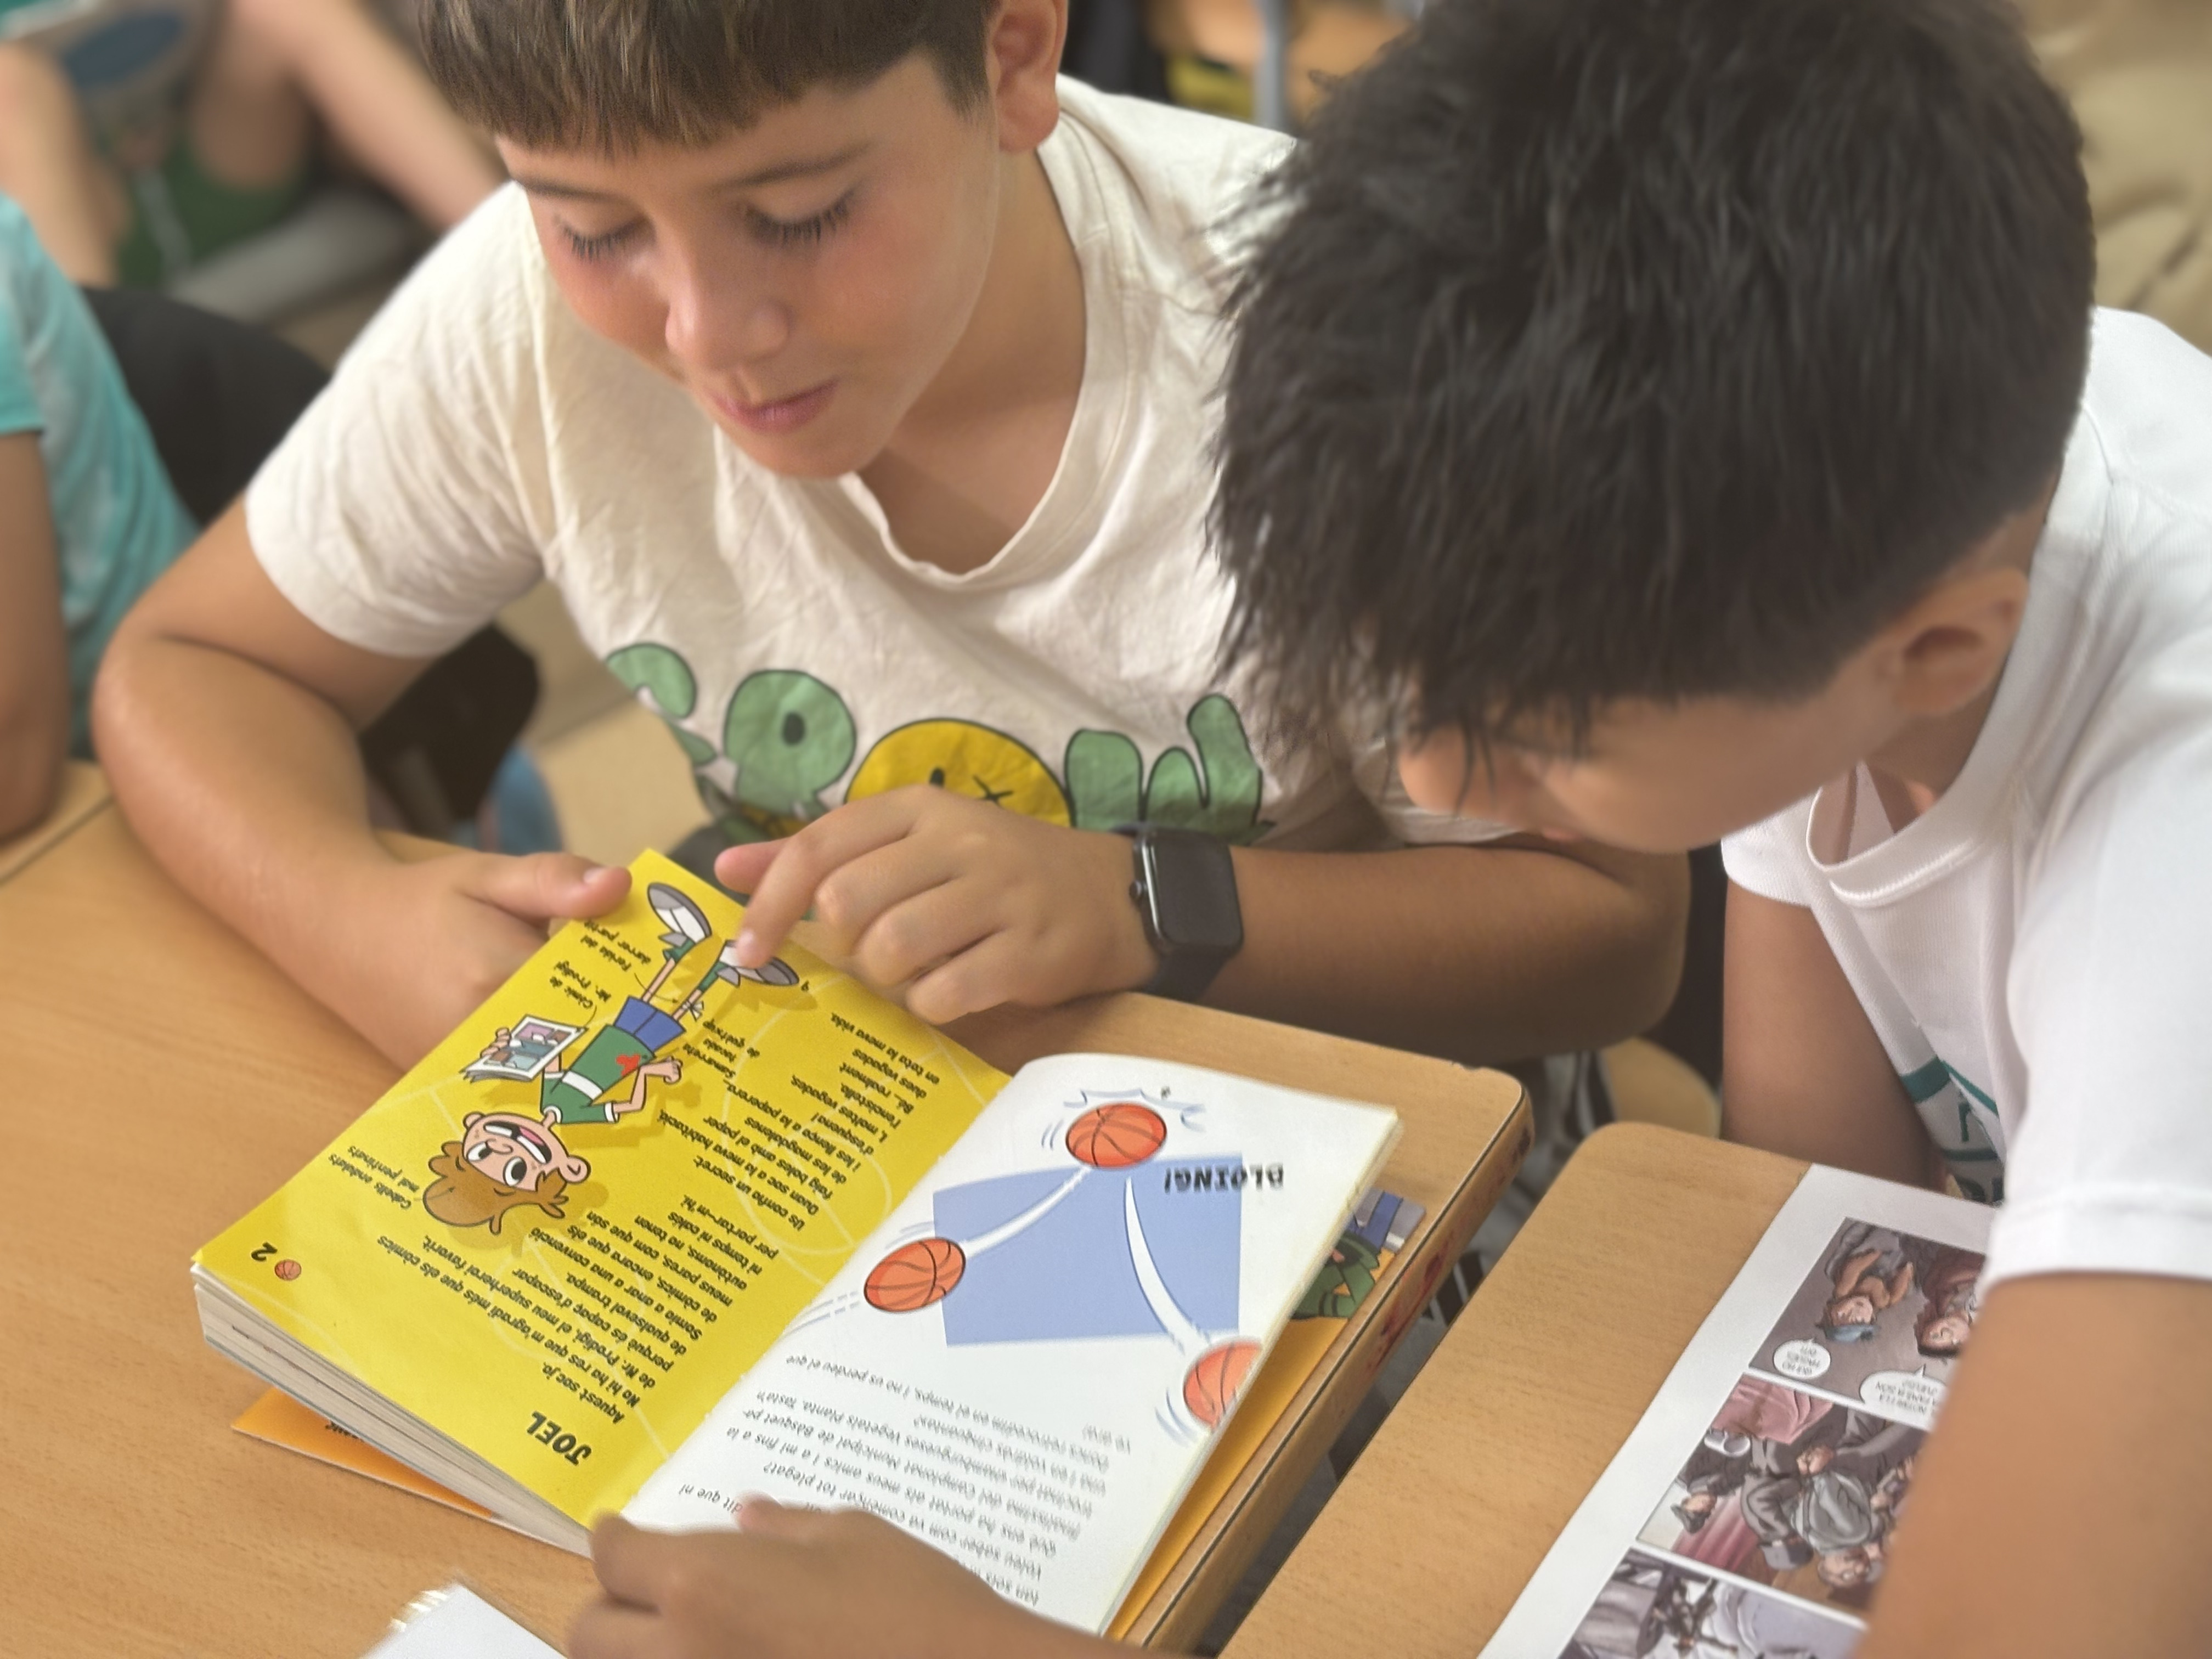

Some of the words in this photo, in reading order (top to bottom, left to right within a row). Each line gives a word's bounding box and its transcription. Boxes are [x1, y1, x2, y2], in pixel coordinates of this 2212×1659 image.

[580, 935, 598, 947] del
[549, 976, 563, 988] de
[831, 1013, 855, 1032] vida.
[855, 1029, 885, 1051] meva
[746, 1047, 760, 1058] de
[885, 1047, 899, 1061] la
[852, 1049, 898, 1080] vegades
[898, 1055, 923, 1076] tota
[839, 1063, 891, 1097] realment
[899, 1077, 927, 1098] dues
[924, 1071, 939, 1085] en
[791, 1075, 837, 1109] vegades,
[840, 1084, 900, 1128] l'encistello.
[894, 1093, 914, 1114] Bé...
[657, 1109, 713, 1149] habitació,
[703, 1116, 740, 1139] paper
[778, 1115, 792, 1128] la
[791, 1122, 802, 1132] a
[838, 1106, 878, 1135] moltes
[735, 1135, 750, 1147] el
[744, 1117, 812, 1161] magdalenes
[811, 1113, 873, 1155] d'esquena!
[878, 1130, 888, 1143] I,
[712, 1144, 744, 1167] meva
[750, 1143, 776, 1162] amb
[836, 1150, 855, 1168] les
[348, 1146, 402, 1180] pentinats
[744, 1162, 758, 1177] la
[776, 1159, 808, 1184] boles
[812, 1158, 831, 1176] les
[852, 1161, 861, 1172] i
[757, 1170, 767, 1180] a
[831, 1170, 847, 1184] de
[735, 1180, 752, 1194] un
[766, 1176, 789, 1194] soc
[808, 1177, 832, 1200] faig
[752, 1190, 788, 1217] confio
[789, 1190, 819, 1215] Quan
[586, 1211, 610, 1229] són
[634, 1216, 667, 1242] tenen
[668, 1212, 699, 1234] calés
[788, 1214, 805, 1231] Us
[567, 1224, 587, 1242] els
[610, 1225, 633, 1243] que
[667, 1235, 685, 1250] no
[696, 1231, 713, 1243] ni
[251, 1242, 278, 1262] 2
[377, 1236, 420, 1265] còmics
[422, 1235, 466, 1269] favorit,
[529, 1227, 590, 1267] convenció
[587, 1237, 611, 1254] que
[633, 1239, 659, 1260] com
[712, 1238, 749, 1268] temps
[754, 1242, 779, 1260] per
[420, 1262, 440, 1278] els
[590, 1263, 614, 1282] una
[610, 1251, 653, 1281] encara
[662, 1255, 701, 1284] pares,
[687, 1245, 746, 1290] autònoms,
[746, 1262, 762, 1275] ni
[440, 1274, 464, 1292] que
[464, 1265, 532, 1308] superheroi
[512, 1269, 572, 1308] d'escapar
[566, 1273, 611, 1308] trampa.
[613, 1278, 624, 1288] a
[463, 1289, 490, 1310] més
[623, 1285, 653, 1306] anar
[657, 1276, 700, 1311] còmics,
[698, 1280, 732, 1306] meus
[532, 1305, 560, 1325] meu
[653, 1302, 664, 1313] a
[700, 1307, 717, 1323] de
[488, 1306, 544, 1342] m'agradi
[573, 1304, 611, 1331] capaç
[610, 1303, 669, 1342] qualsevol
[664, 1310, 702, 1341] Somio
[555, 1322, 572, 1334] el
[610, 1328, 628, 1344] és
[544, 1339, 568, 1357] que
[572, 1329, 619, 1365] Prodigi,
[627, 1339, 674, 1372] perquè
[669, 1340, 686, 1356] de
[568, 1354, 591, 1373] res
[621, 1359, 639, 1379] Mr.
[786, 1355, 807, 1366] que
[542, 1362, 561, 1380] jo.
[590, 1368, 609, 1386] ha
[555, 1373, 580, 1392] soc
[605, 1379, 623, 1396] hi
[638, 1373, 655, 1389] de
[579, 1389, 624, 1424] Aquest
[622, 1389, 640, 1408] No
[527, 1412, 591, 1464] JOEL
[763, 1462, 816, 1487] plegat?
[678, 1483, 694, 1496] ni
[697, 1488, 720, 1503] que
[816, 1480, 837, 1497] tot
[723, 1497, 746, 1514] dit
